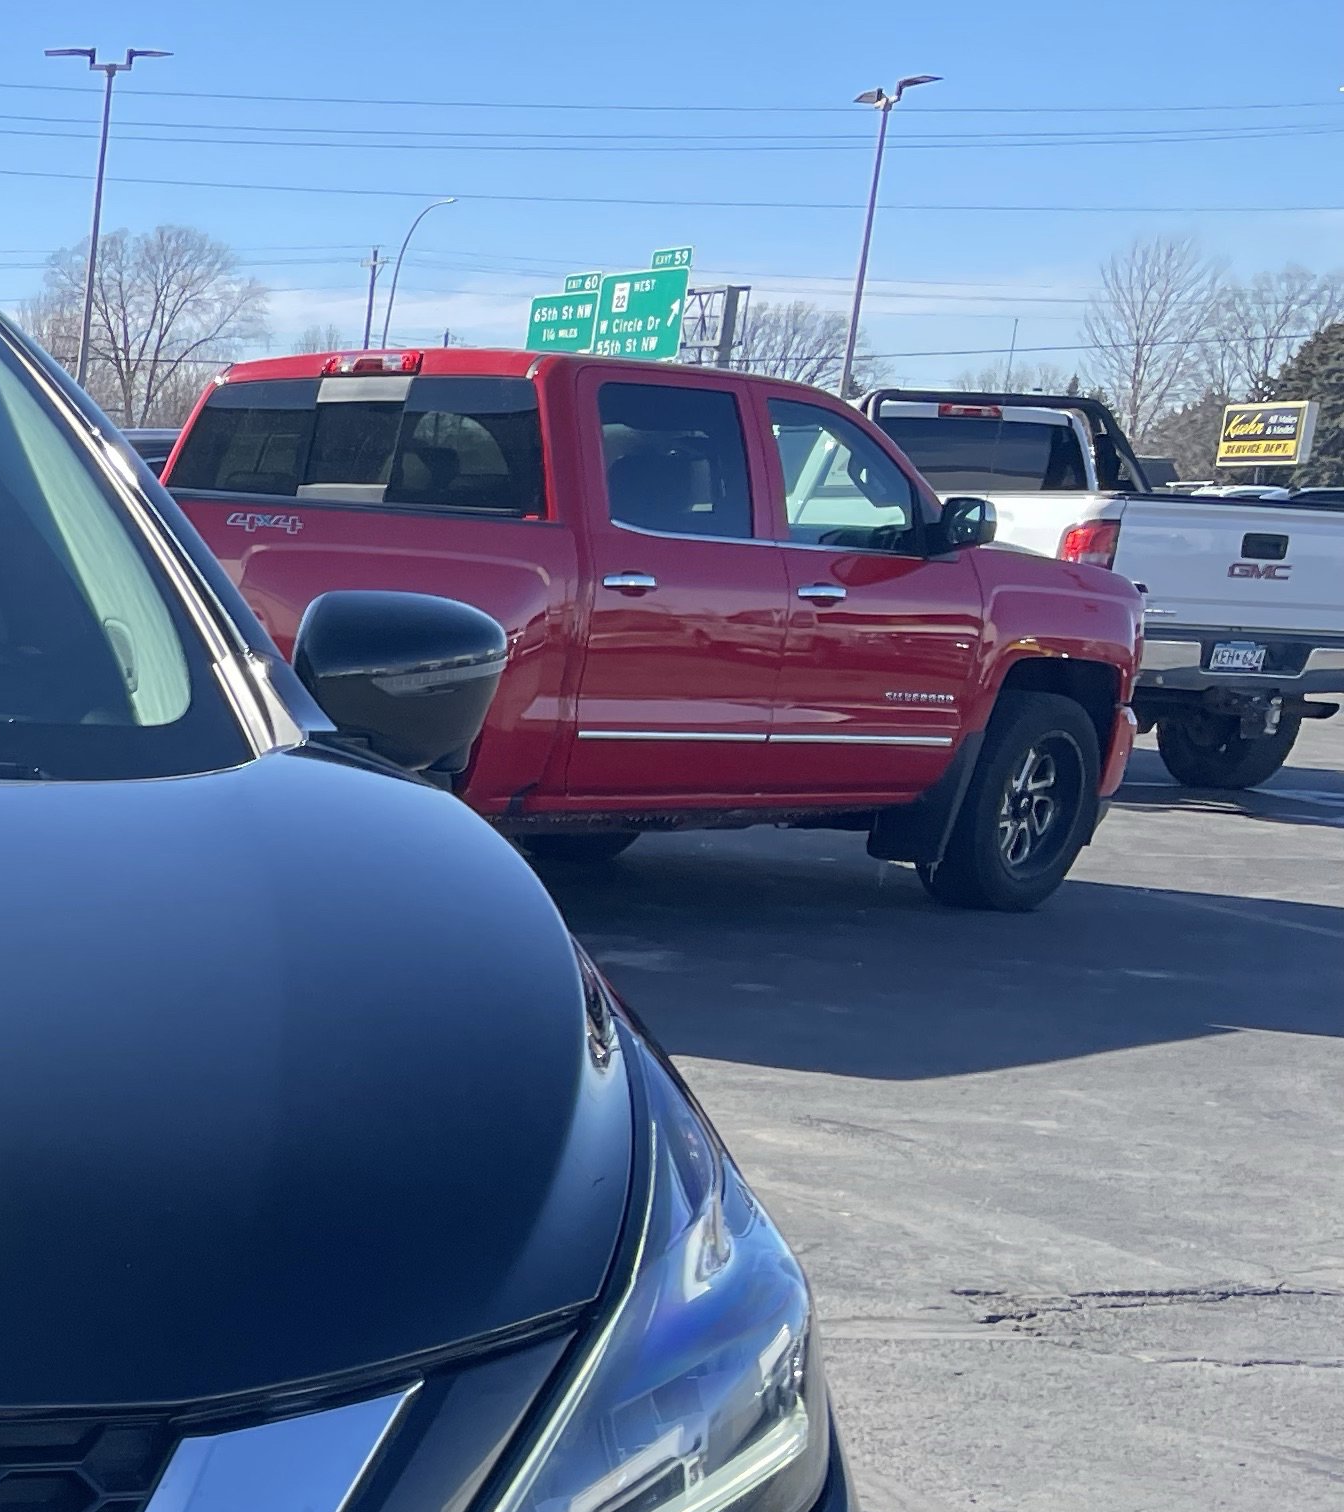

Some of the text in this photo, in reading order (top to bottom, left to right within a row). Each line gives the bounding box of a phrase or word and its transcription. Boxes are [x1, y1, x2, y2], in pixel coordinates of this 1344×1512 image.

[655, 251, 688, 264] EXIT 59
[567, 276, 598, 289] EXIT 60
[634, 280, 656, 291] WEST
[616, 296, 625, 308] 22
[534, 304, 592, 322] 65th St NW
[600, 316, 660, 334] W Circle Dr
[558, 328, 577, 338] MILES
[596, 337, 658, 356] 55th St NW
[1224, 412, 1265, 439] Kuehn
[1224, 442, 1289, 455] SERVICE DEPT.
[1227, 563, 1293, 580] GMC
